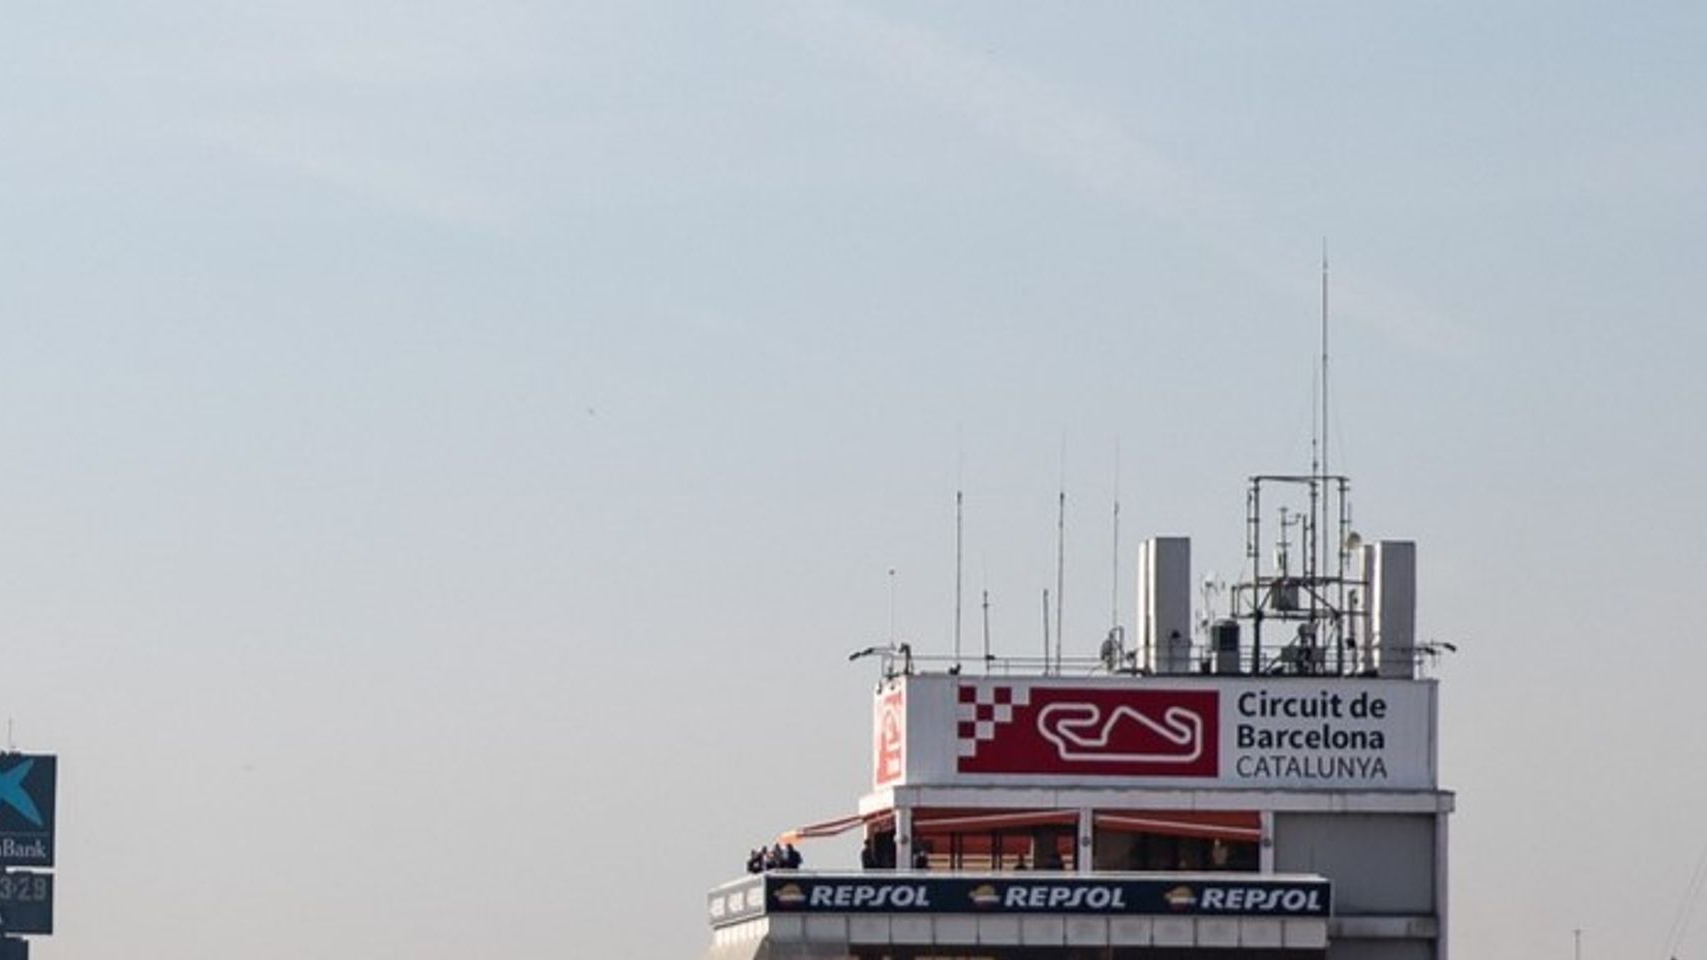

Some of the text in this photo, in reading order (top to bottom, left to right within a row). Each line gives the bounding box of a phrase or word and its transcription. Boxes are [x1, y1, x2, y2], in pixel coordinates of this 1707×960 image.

[1238, 690, 1386, 719] Circuit de
[1238, 724, 1384, 749] Barcelona
[1237, 756, 1387, 779] CATALUNYA
[810, 886, 929, 906] REPSOL
[1005, 887, 1125, 908] REPSOL
[1201, 888, 1320, 910] REPSOL
